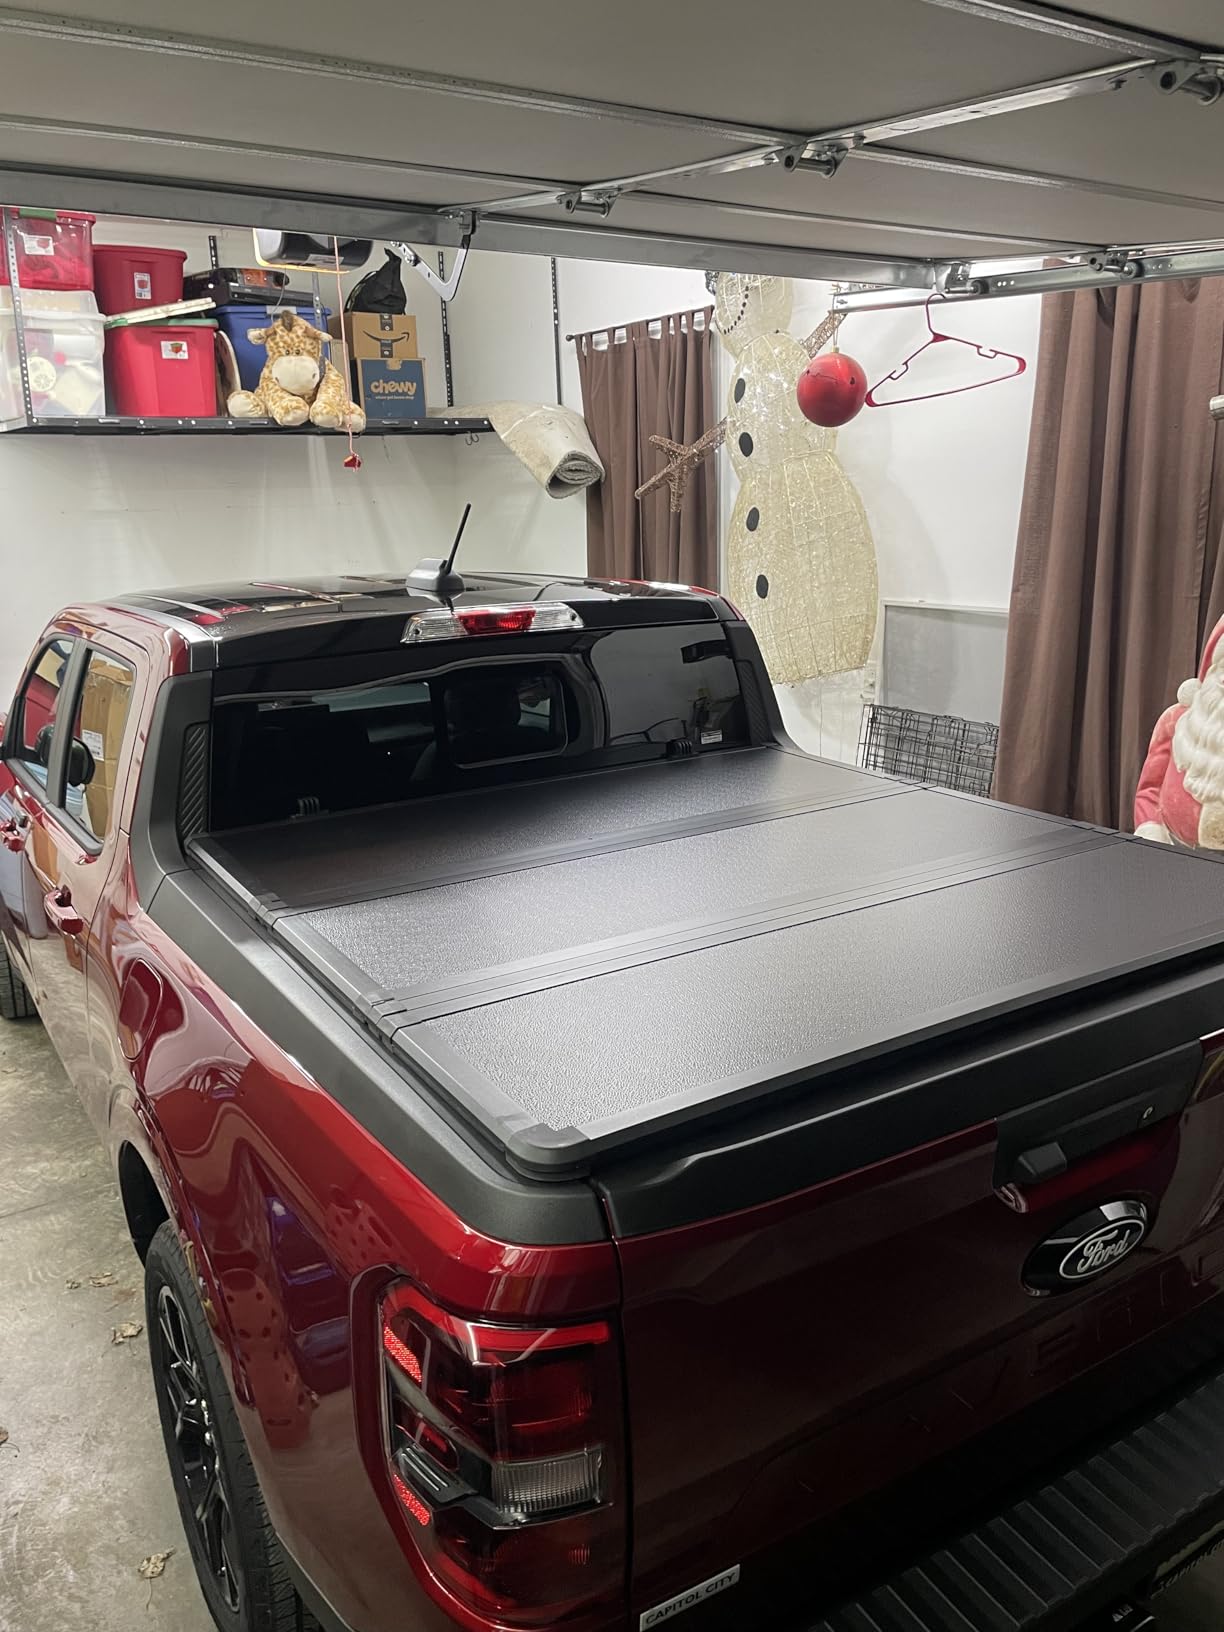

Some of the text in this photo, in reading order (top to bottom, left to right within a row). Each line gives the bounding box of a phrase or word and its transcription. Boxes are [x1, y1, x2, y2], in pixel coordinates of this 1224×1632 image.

[370, 379, 416, 395] chewy
[1077, 1229, 1130, 1273] Ford
[646, 1572, 735, 1624] CAPITOL CITY
